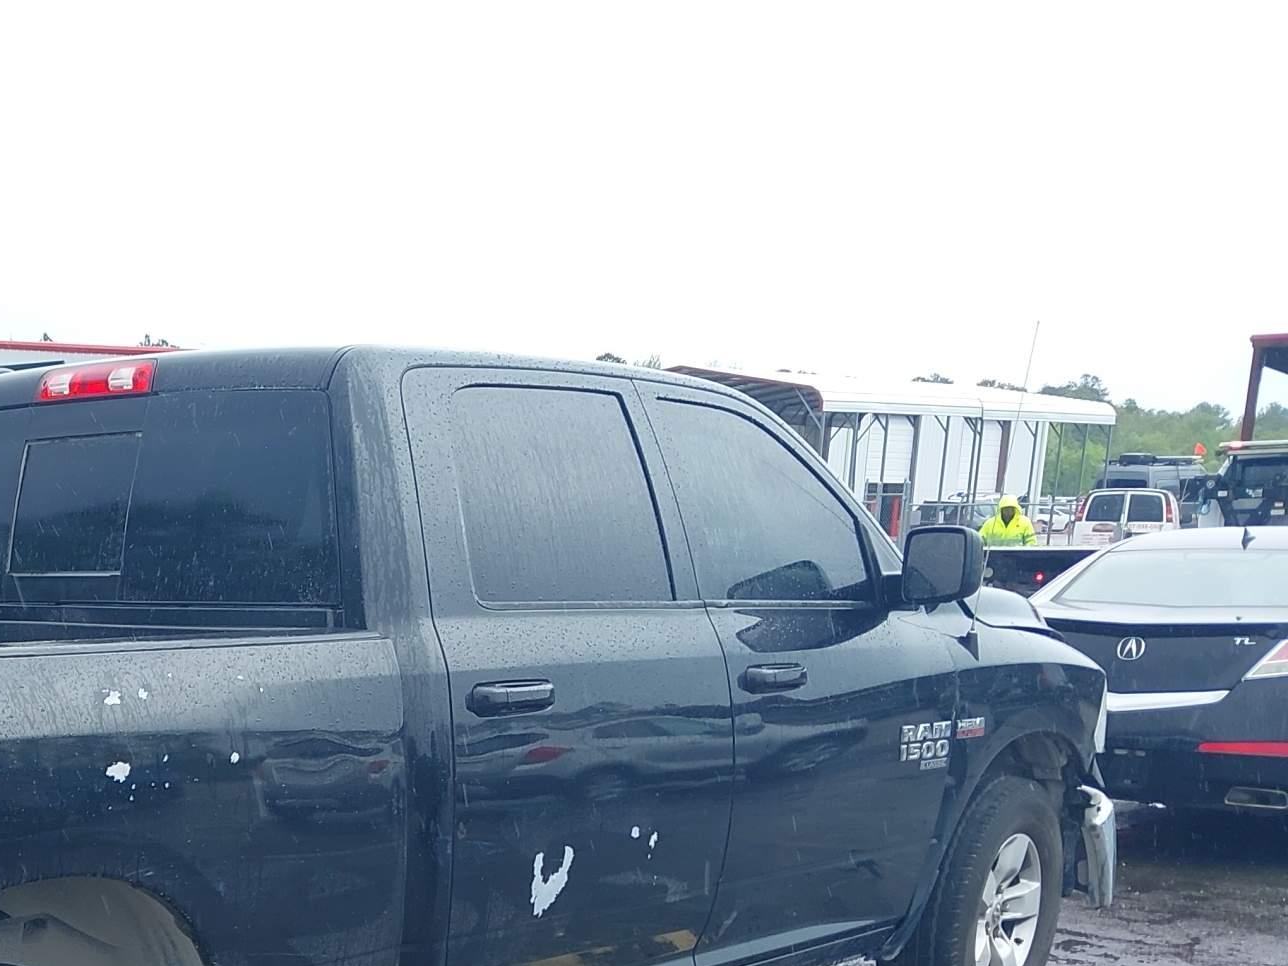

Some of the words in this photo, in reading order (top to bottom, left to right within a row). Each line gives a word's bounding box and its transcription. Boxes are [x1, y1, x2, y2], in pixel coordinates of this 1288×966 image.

[1233, 637, 1257, 645] TL
[900, 720, 952, 743] RAM
[899, 739, 950, 761] 1500
